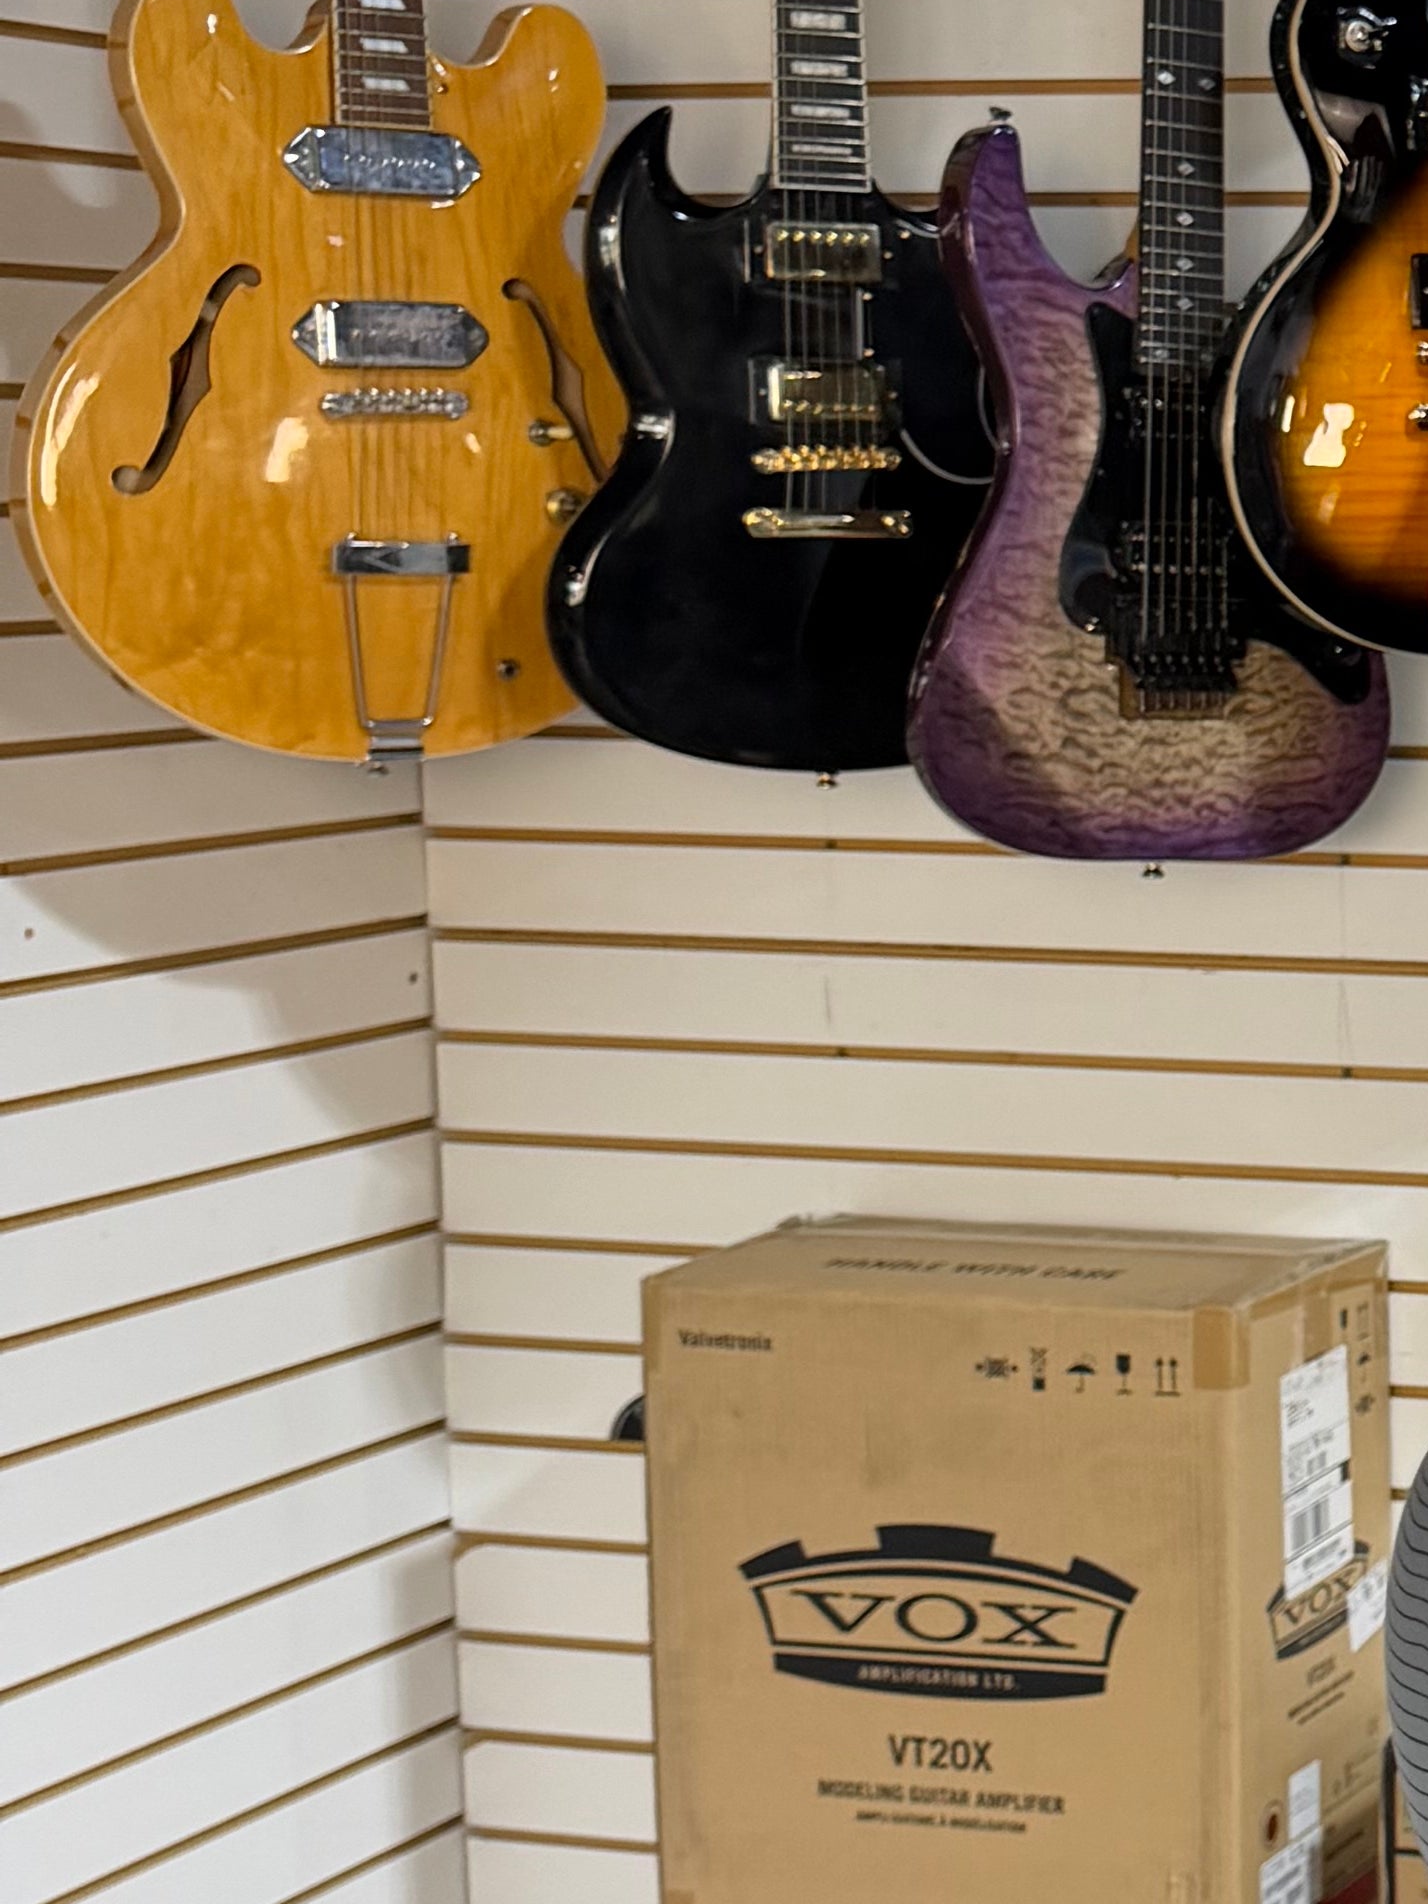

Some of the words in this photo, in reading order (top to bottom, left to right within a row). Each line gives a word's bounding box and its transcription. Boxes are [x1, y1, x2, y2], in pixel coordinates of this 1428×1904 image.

[789, 1588, 1078, 1650] VOX
[887, 1732, 993, 1773] VT20X
[817, 1778, 905, 1803] MODELING
[908, 1785, 973, 1809] GUITAR
[975, 1790, 1066, 1816] AMPLIFIER
